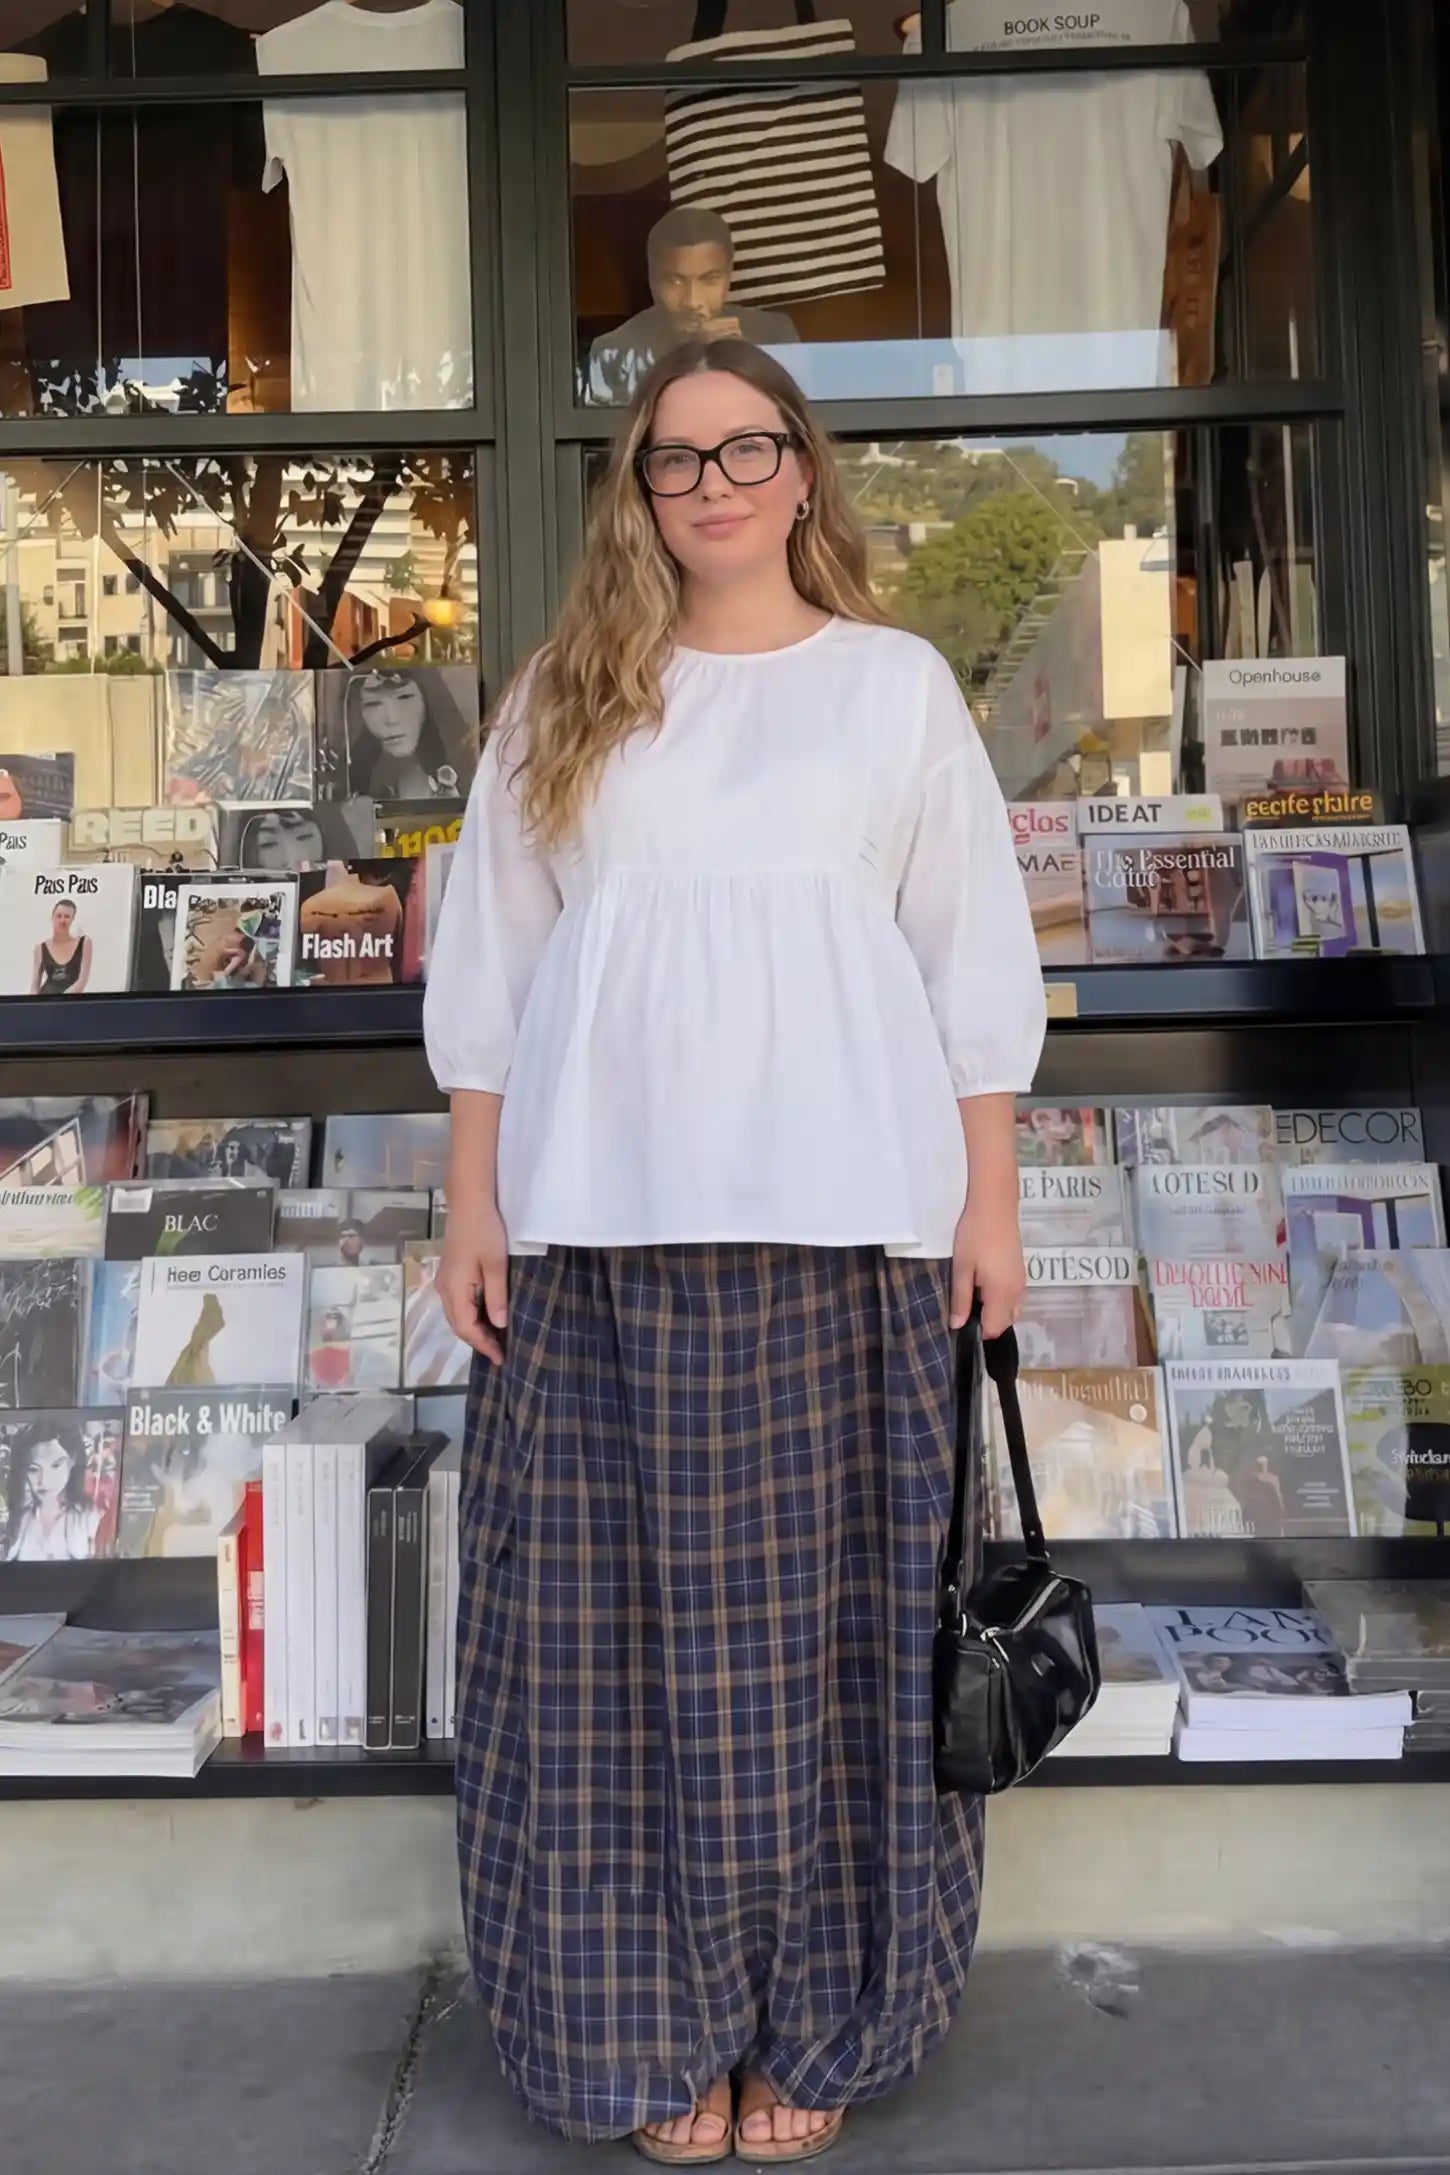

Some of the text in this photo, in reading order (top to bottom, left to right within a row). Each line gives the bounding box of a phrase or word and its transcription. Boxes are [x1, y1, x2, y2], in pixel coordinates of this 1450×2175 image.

[1004, 13, 1100, 36] BOOK SOUP
[1229, 668, 1322, 687] Openhouse
[1088, 804, 1162, 823] IDEAT
[302, 931, 394, 960] Flash Art
[130, 1402, 287, 1437] Black & White
